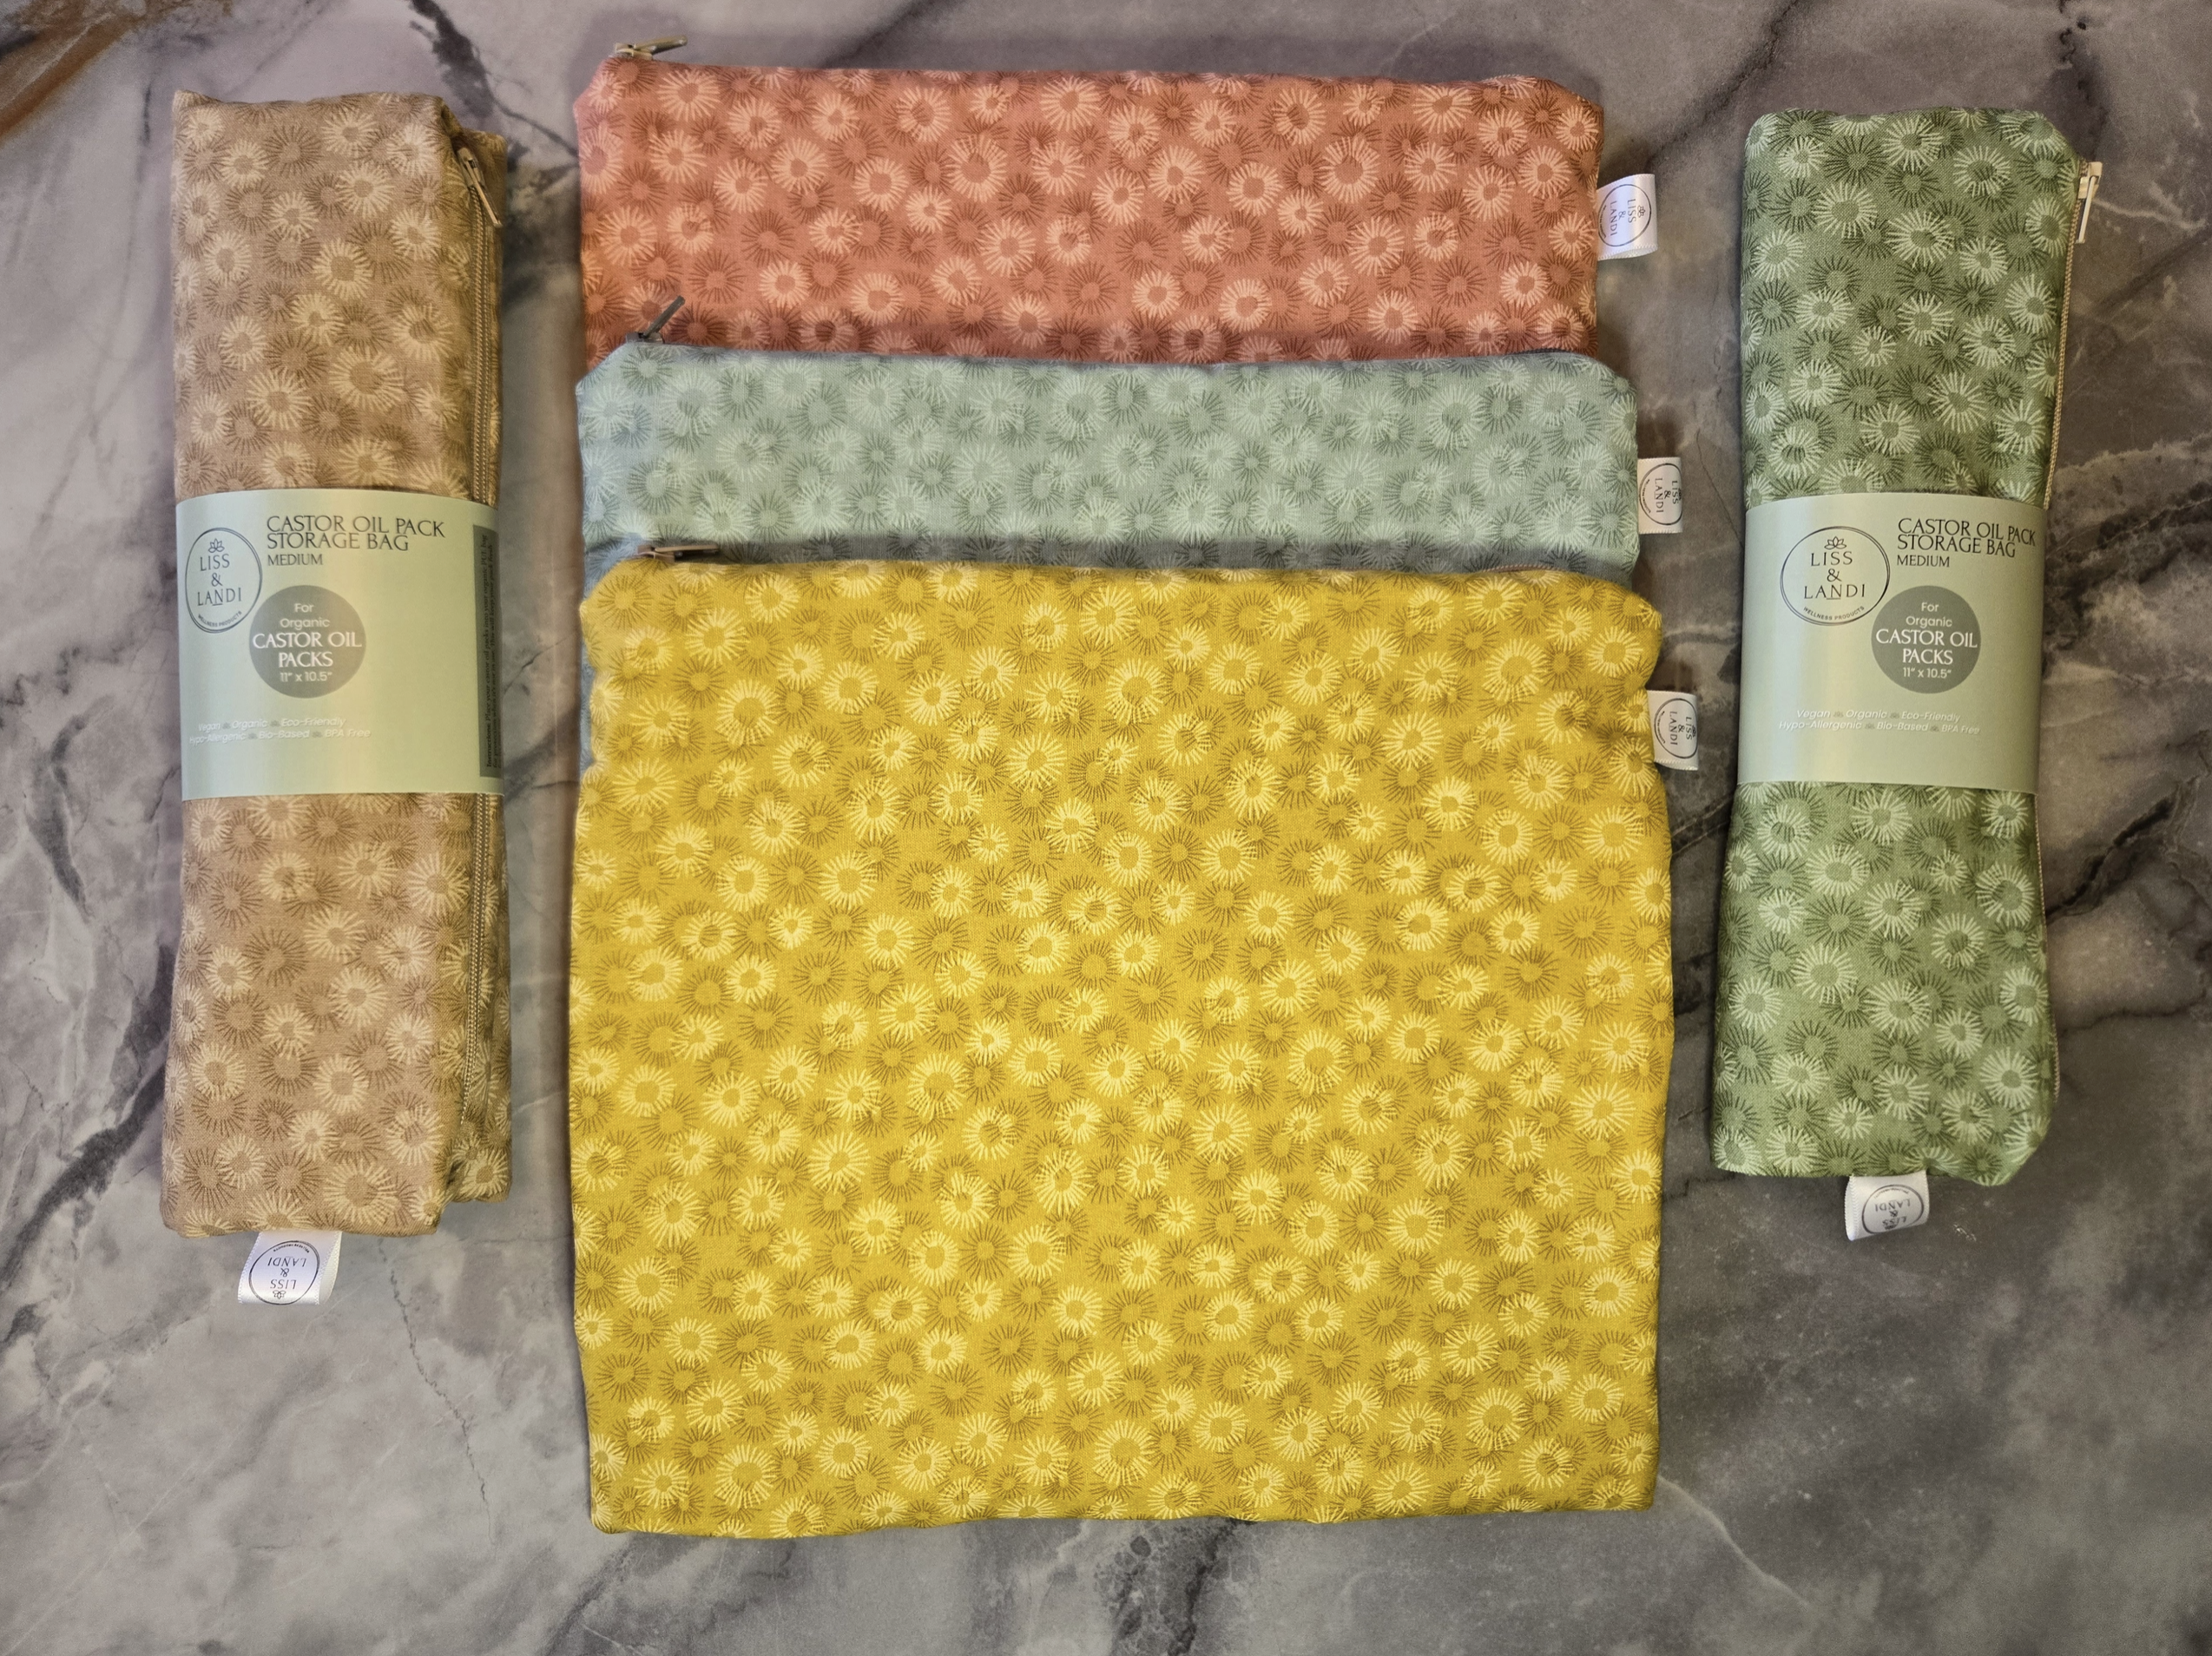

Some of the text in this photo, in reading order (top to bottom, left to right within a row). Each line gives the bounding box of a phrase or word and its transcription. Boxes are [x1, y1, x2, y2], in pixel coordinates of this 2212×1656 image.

[1610, 200, 1618, 236] LANDI
[1618, 210, 1626, 220] &
[1628, 199, 1636, 223] LISS
[1655, 477, 1664, 513] LANDI
[1663, 490, 1671, 500] &
[267, 516, 445, 538] CASTOR OIL PACK
[1898, 517, 2036, 547] CASTOR OIL PACK
[267, 532, 409, 551] STORAGE BAG
[1898, 534, 2016, 558] STORAGE BAG
[200, 553, 230, 571] LISS
[267, 554, 323, 566] MEDIUM
[1811, 550, 1853, 567] LISS
[1897, 555, 1950, 568] MEDIUM
[211, 572, 223, 587] &
[1827, 568, 1842, 582] &
[197, 587, 242, 606] LANDI
[1804, 583, 1865, 600] LANDI
[294, 602, 314, 613] For
[1803, 606, 1865, 621] WELLNESS PRODUCTS
[1921, 601, 1939, 613] For
[198, 610, 242, 628] WELLNESS PRODUCTS
[280, 617, 330, 630] Organic
[1906, 615, 1952, 629] Organic
[253, 632, 362, 649] CASTOR OIL
[1875, 628, 1978, 649] CASTOR OIL
[278, 652, 333, 667] PACKS
[1902, 648, 1953, 666] PACKS
[1796, 709, 1961, 723] Vegan Organic Eco-Friendly
[198, 717, 346, 733] Vegan Organic Eco-Friendly
[1669, 711, 1678, 746] LANDI
[1678, 724, 1685, 733] &
[1876, 721, 1929, 732] Bio-Based
[1941, 724, 1959, 733] BPA
[1960, 725, 1980, 735] Free
[258, 730, 310, 740] Bio-Based
[325, 729, 345, 738] BPA
[347, 729, 372, 738] Free
[1875, 1199, 1911, 1212] LANDI
[1882, 1216, 1906, 1226] LISS
[267, 1256, 306, 1267] LANDI
[280, 1267, 290, 1278] &
[270, 1278, 297, 1290] LISS
